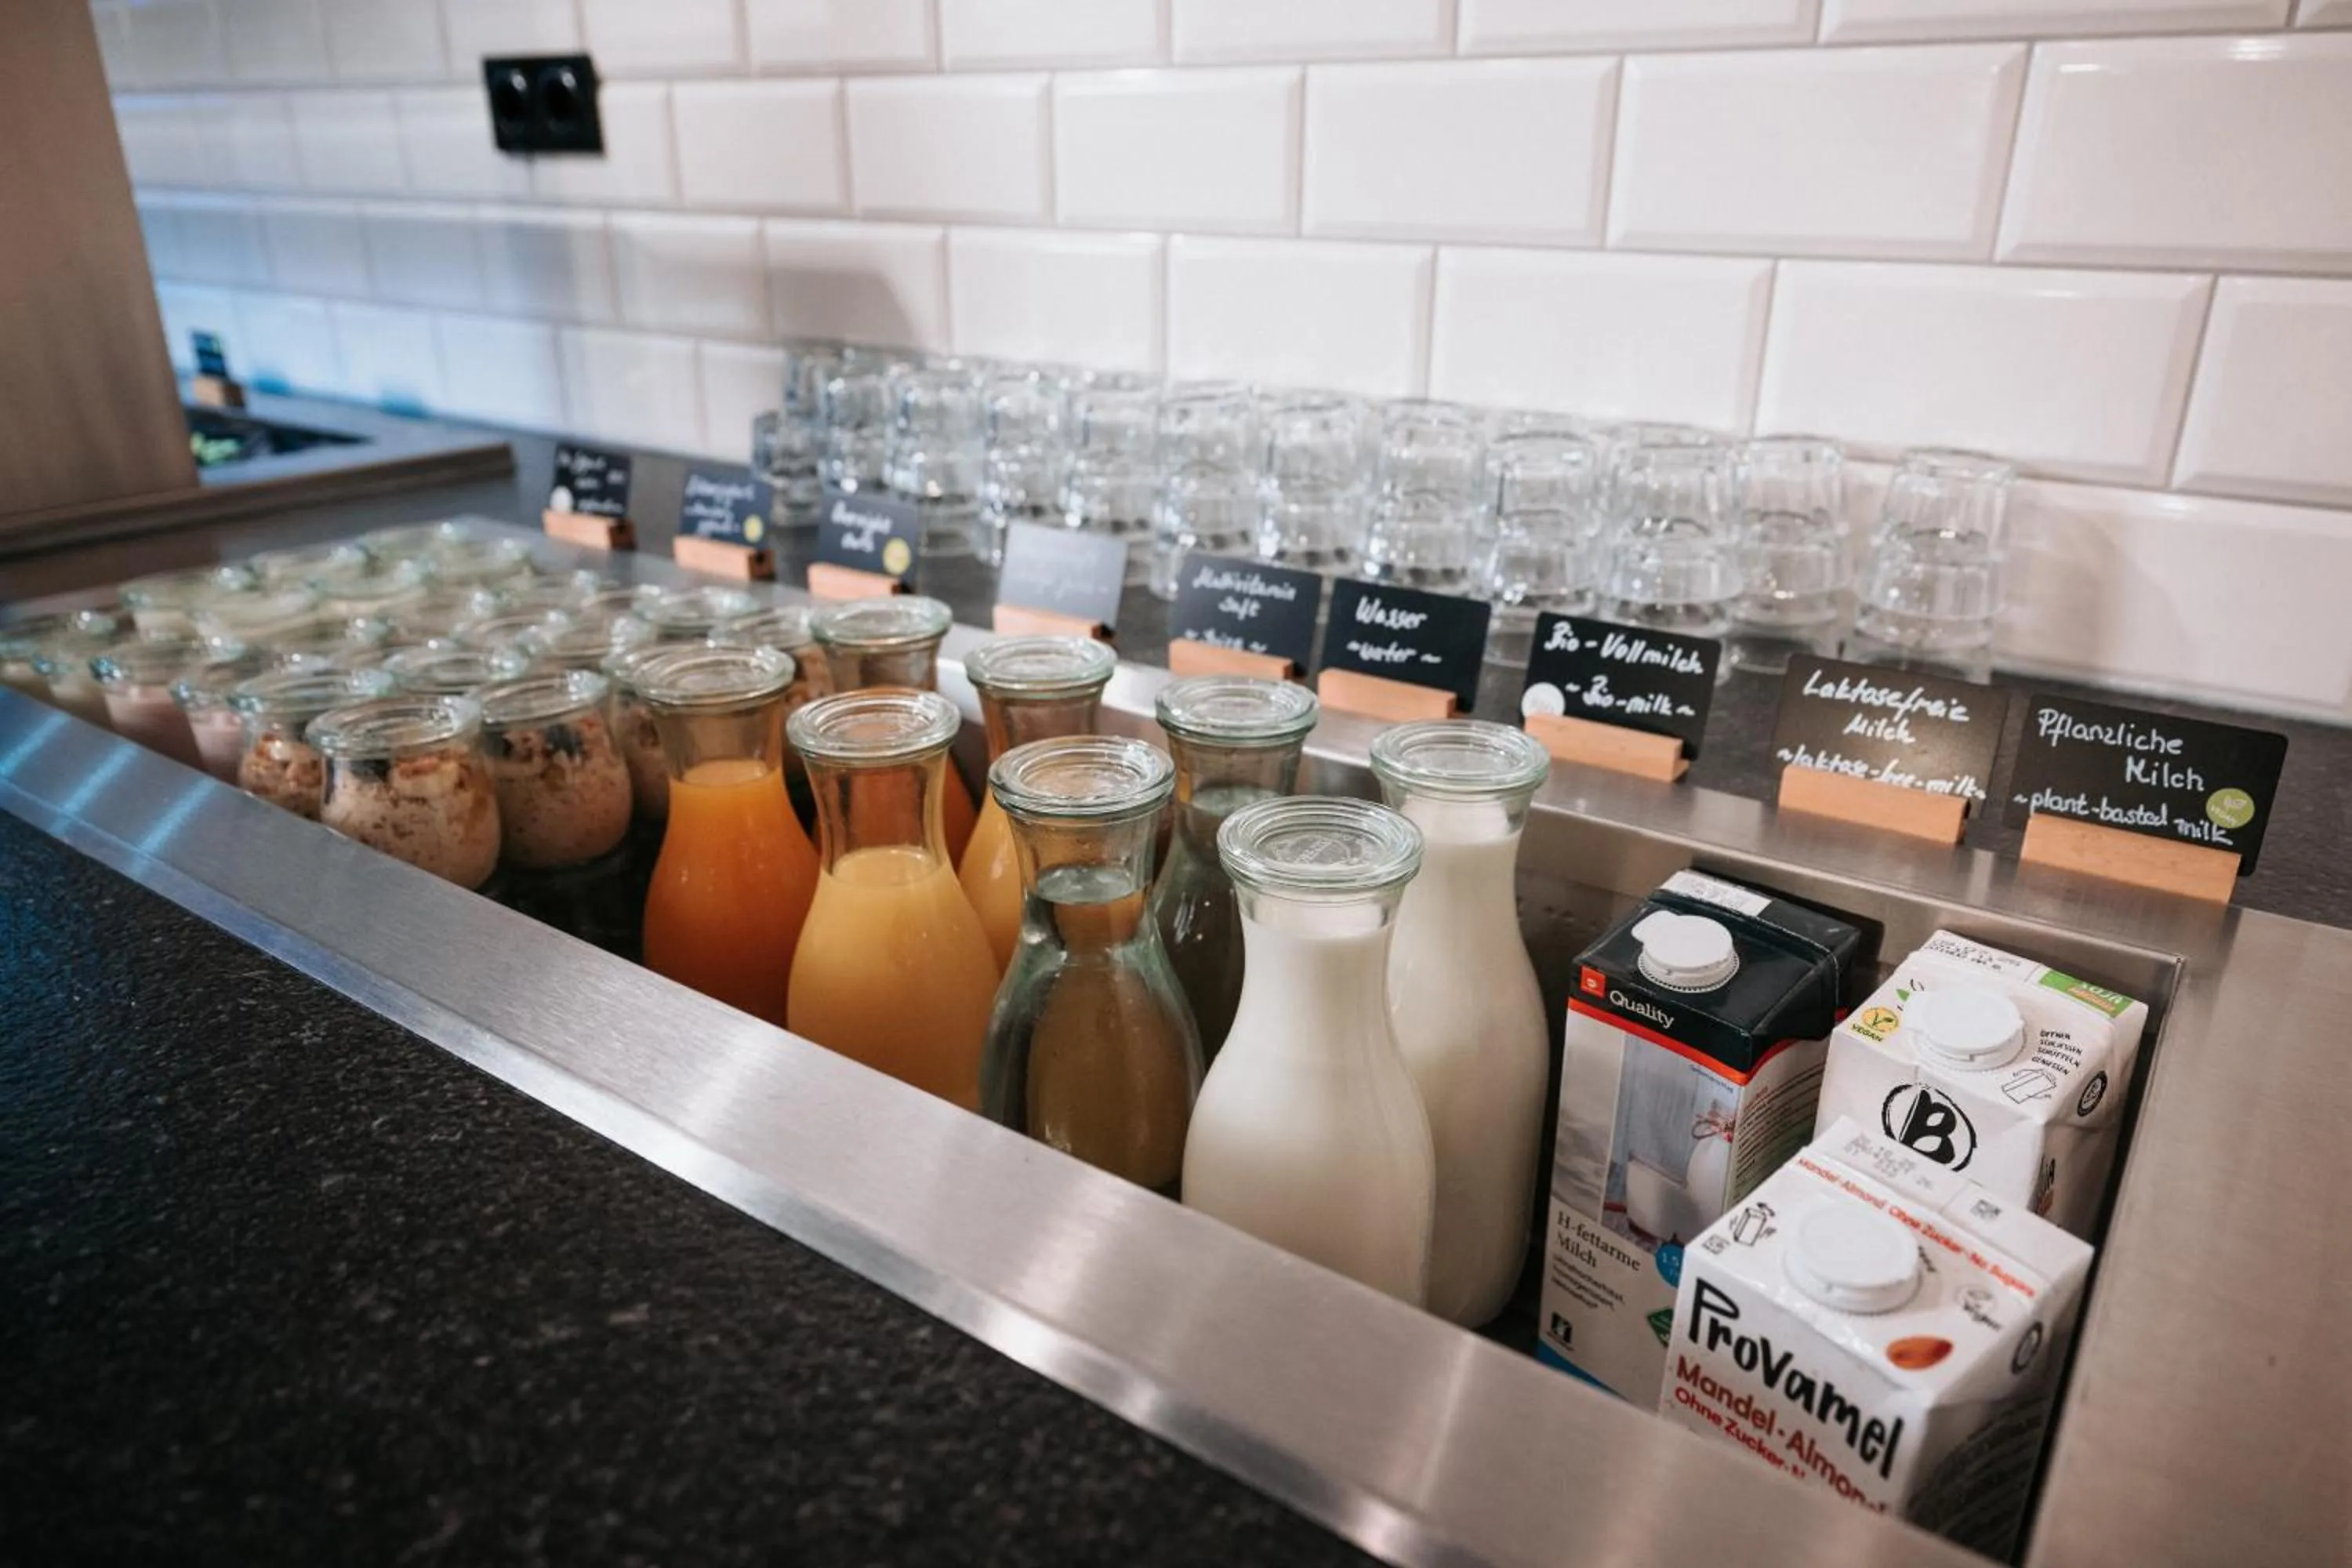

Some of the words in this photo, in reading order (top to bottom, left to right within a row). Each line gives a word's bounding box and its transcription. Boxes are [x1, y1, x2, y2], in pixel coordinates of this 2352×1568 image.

[1356, 595, 1428, 630] Wasser
[1842, 712, 1916, 744] Milch
[2038, 708, 2184, 756] Pflanzliche
[2125, 755, 2205, 793] Milch
[2174, 817, 2234, 846] milk
[1609, 990, 1675, 1029] Quality
[1557, 1229, 1599, 1269] Milch
[1675, 1385, 1723, 1427] Ohne
[1725, 1416, 1785, 1471] Zucker
[1676, 1354, 1777, 1436] Mandel
[1785, 1429, 1886, 1513] Almon
